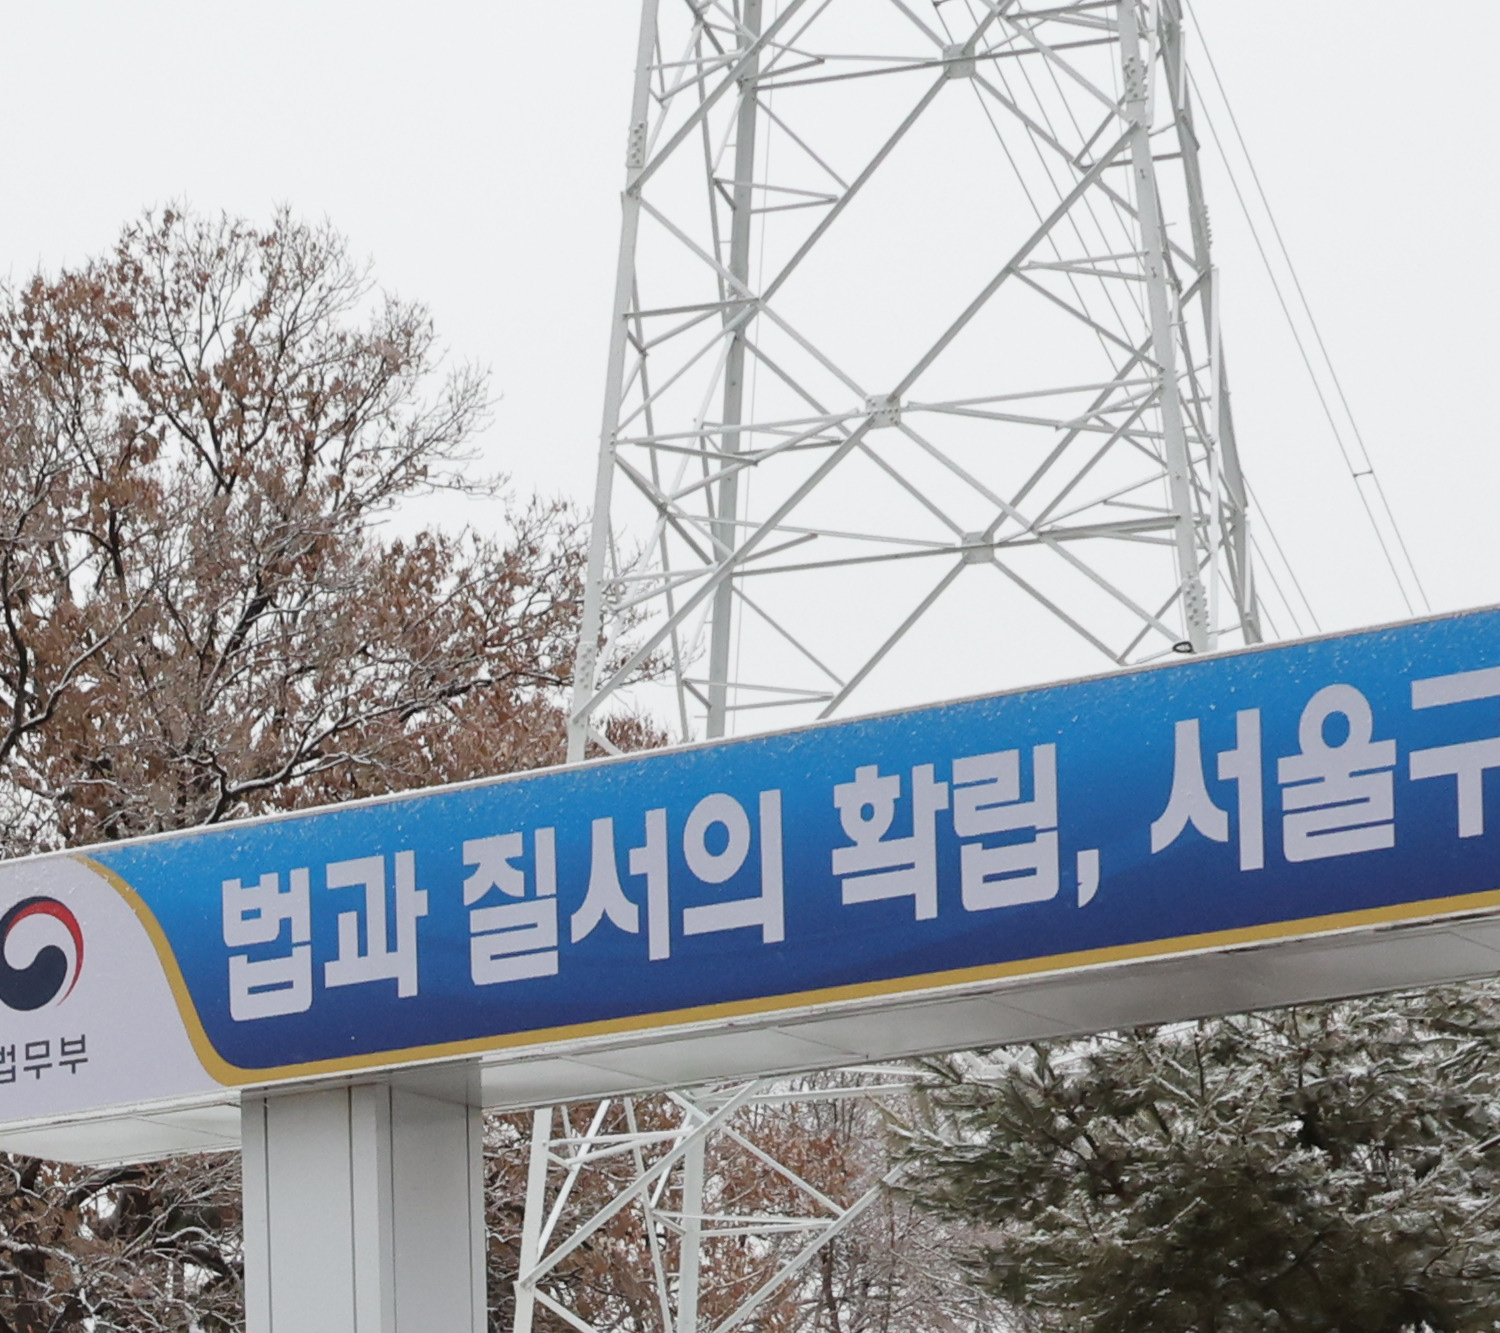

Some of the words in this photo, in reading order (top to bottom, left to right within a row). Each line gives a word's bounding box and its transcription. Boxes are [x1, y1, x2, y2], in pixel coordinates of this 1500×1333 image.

[222, 850, 429, 1022] 법과
[461, 789, 785, 986] 질서의
[831, 742, 1100, 921] 확립,
